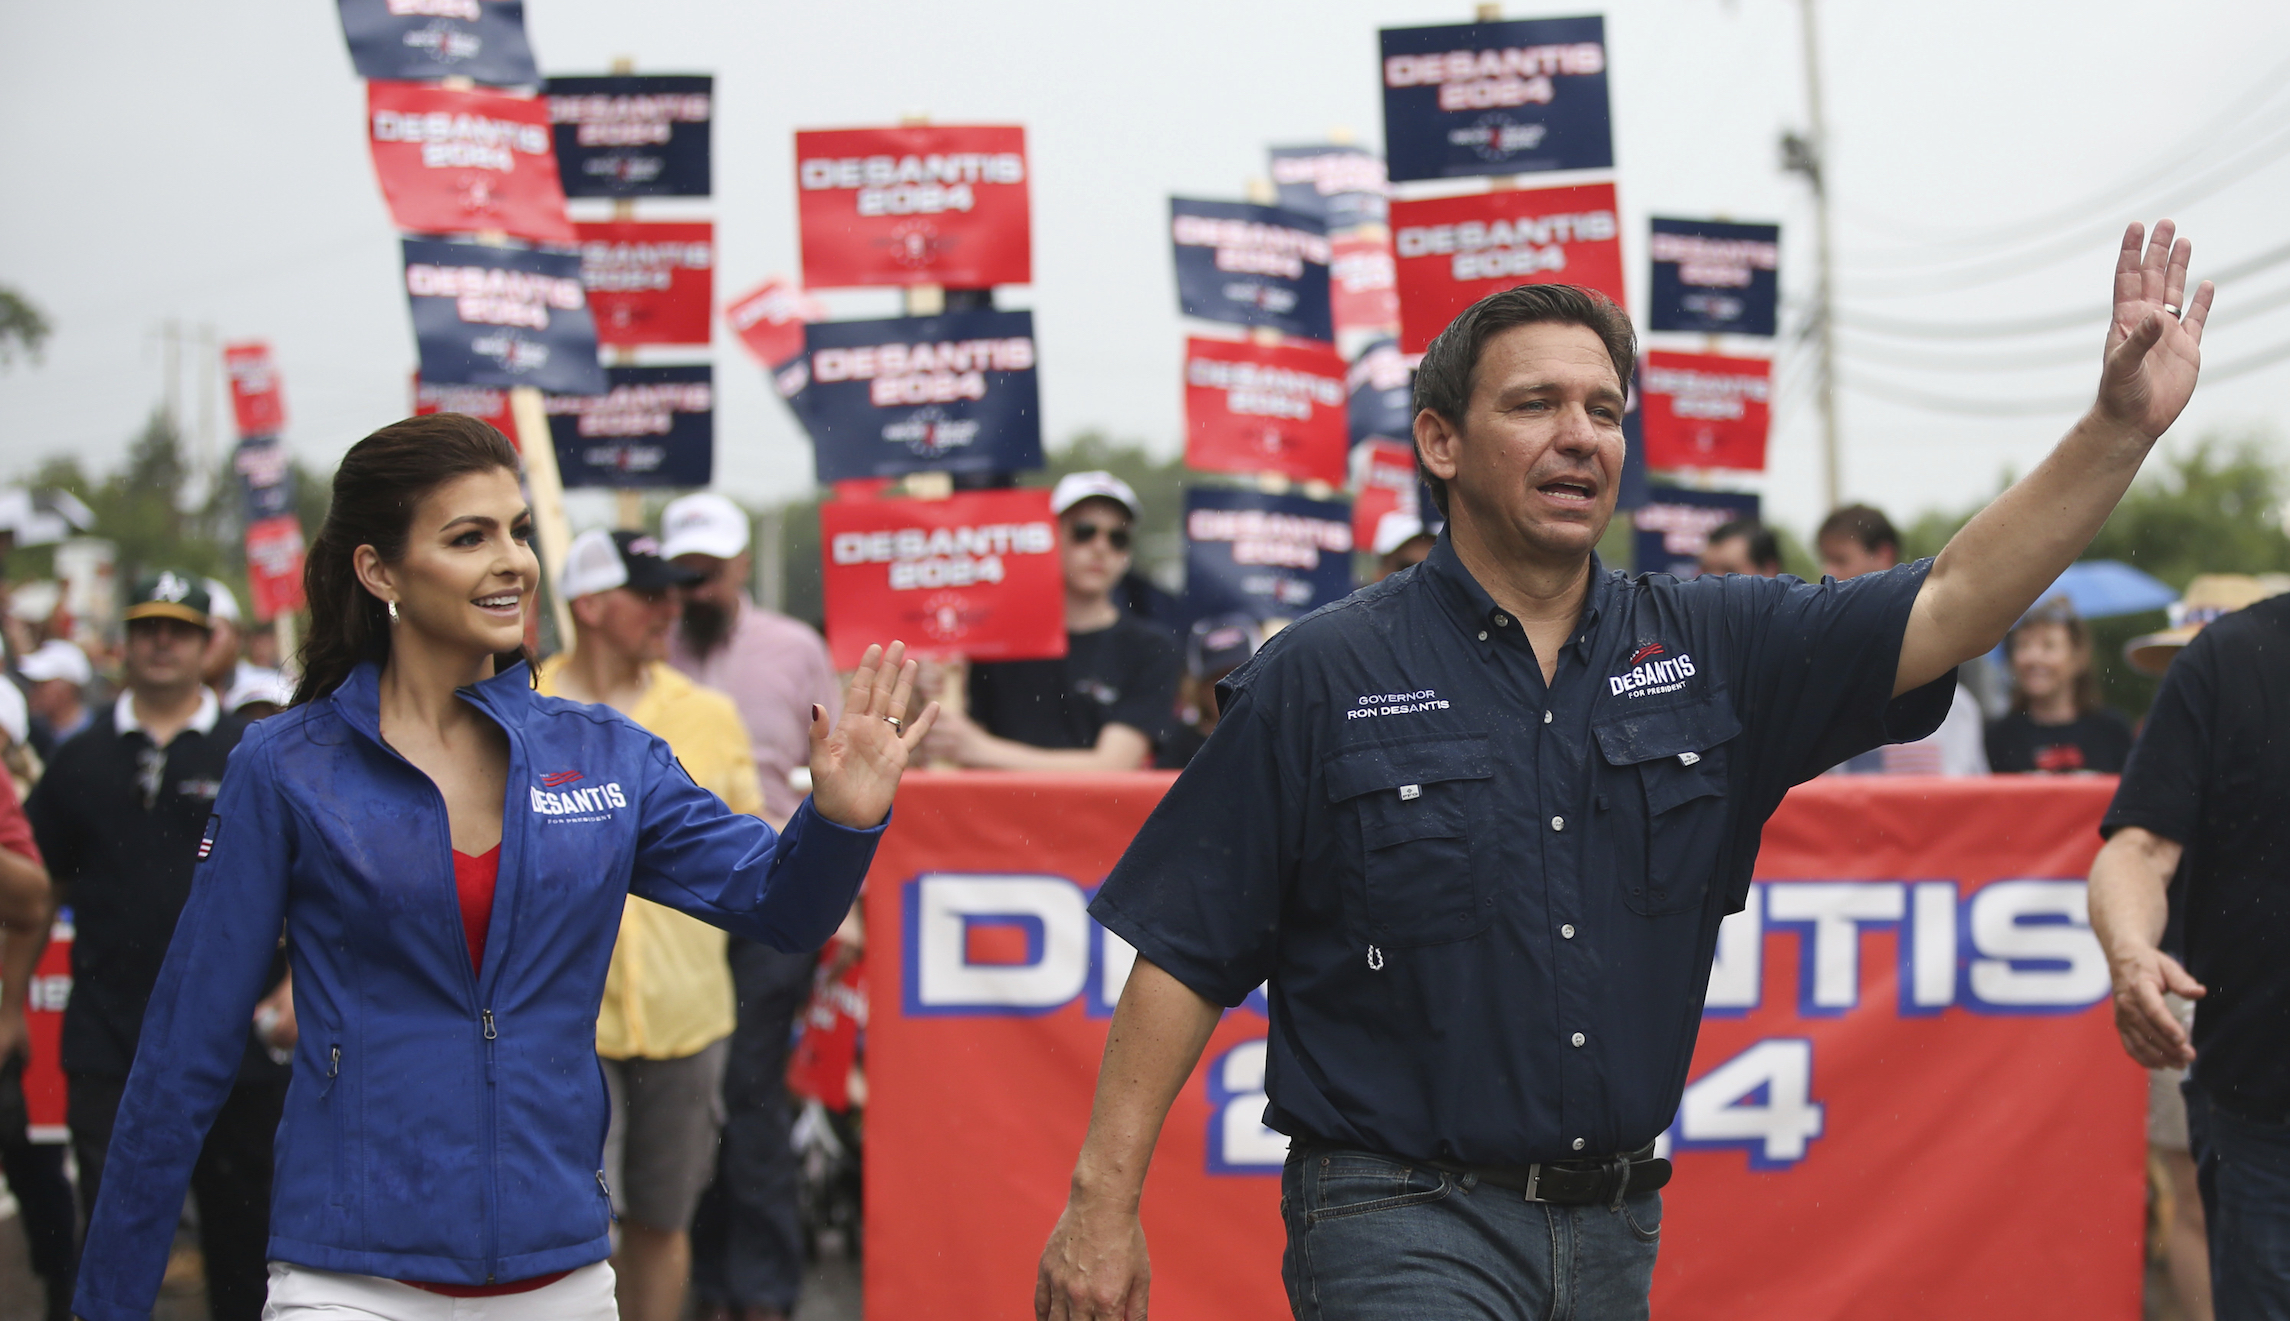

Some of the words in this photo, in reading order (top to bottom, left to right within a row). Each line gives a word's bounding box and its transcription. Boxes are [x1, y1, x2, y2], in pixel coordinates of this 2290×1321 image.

[1385, 42, 1605, 88] DESANTIS
[1438, 76, 1555, 112] 2024
[373, 110, 549, 155] DESANTIS
[421, 142, 516, 174] 2024
[801, 152, 1024, 190] DESANTIS
[857, 183, 973, 216] 2024
[1396, 209, 1617, 258] DESANTIS
[1452, 243, 1567, 281] 2024
[406, 264, 586, 311] DESANTIS
[812, 337, 1034, 383] DESANTIS
[871, 371, 986, 406] 2024
[831, 522, 1054, 565] DESANTIS
[888, 555, 1004, 590] 2024
[1609, 654, 1696, 696] DESANTIS
[1628, 689, 1645, 699] FOR
[1647, 681, 1687, 696] PRESIDENT
[1347, 707, 1378, 720] RON
[1380, 700, 1450, 716] DESANTIS
[1358, 690, 1436, 705] GOVERNOR
[530, 783, 627, 815] DESANTIS
[566, 814, 612, 824] PRESIDENT
